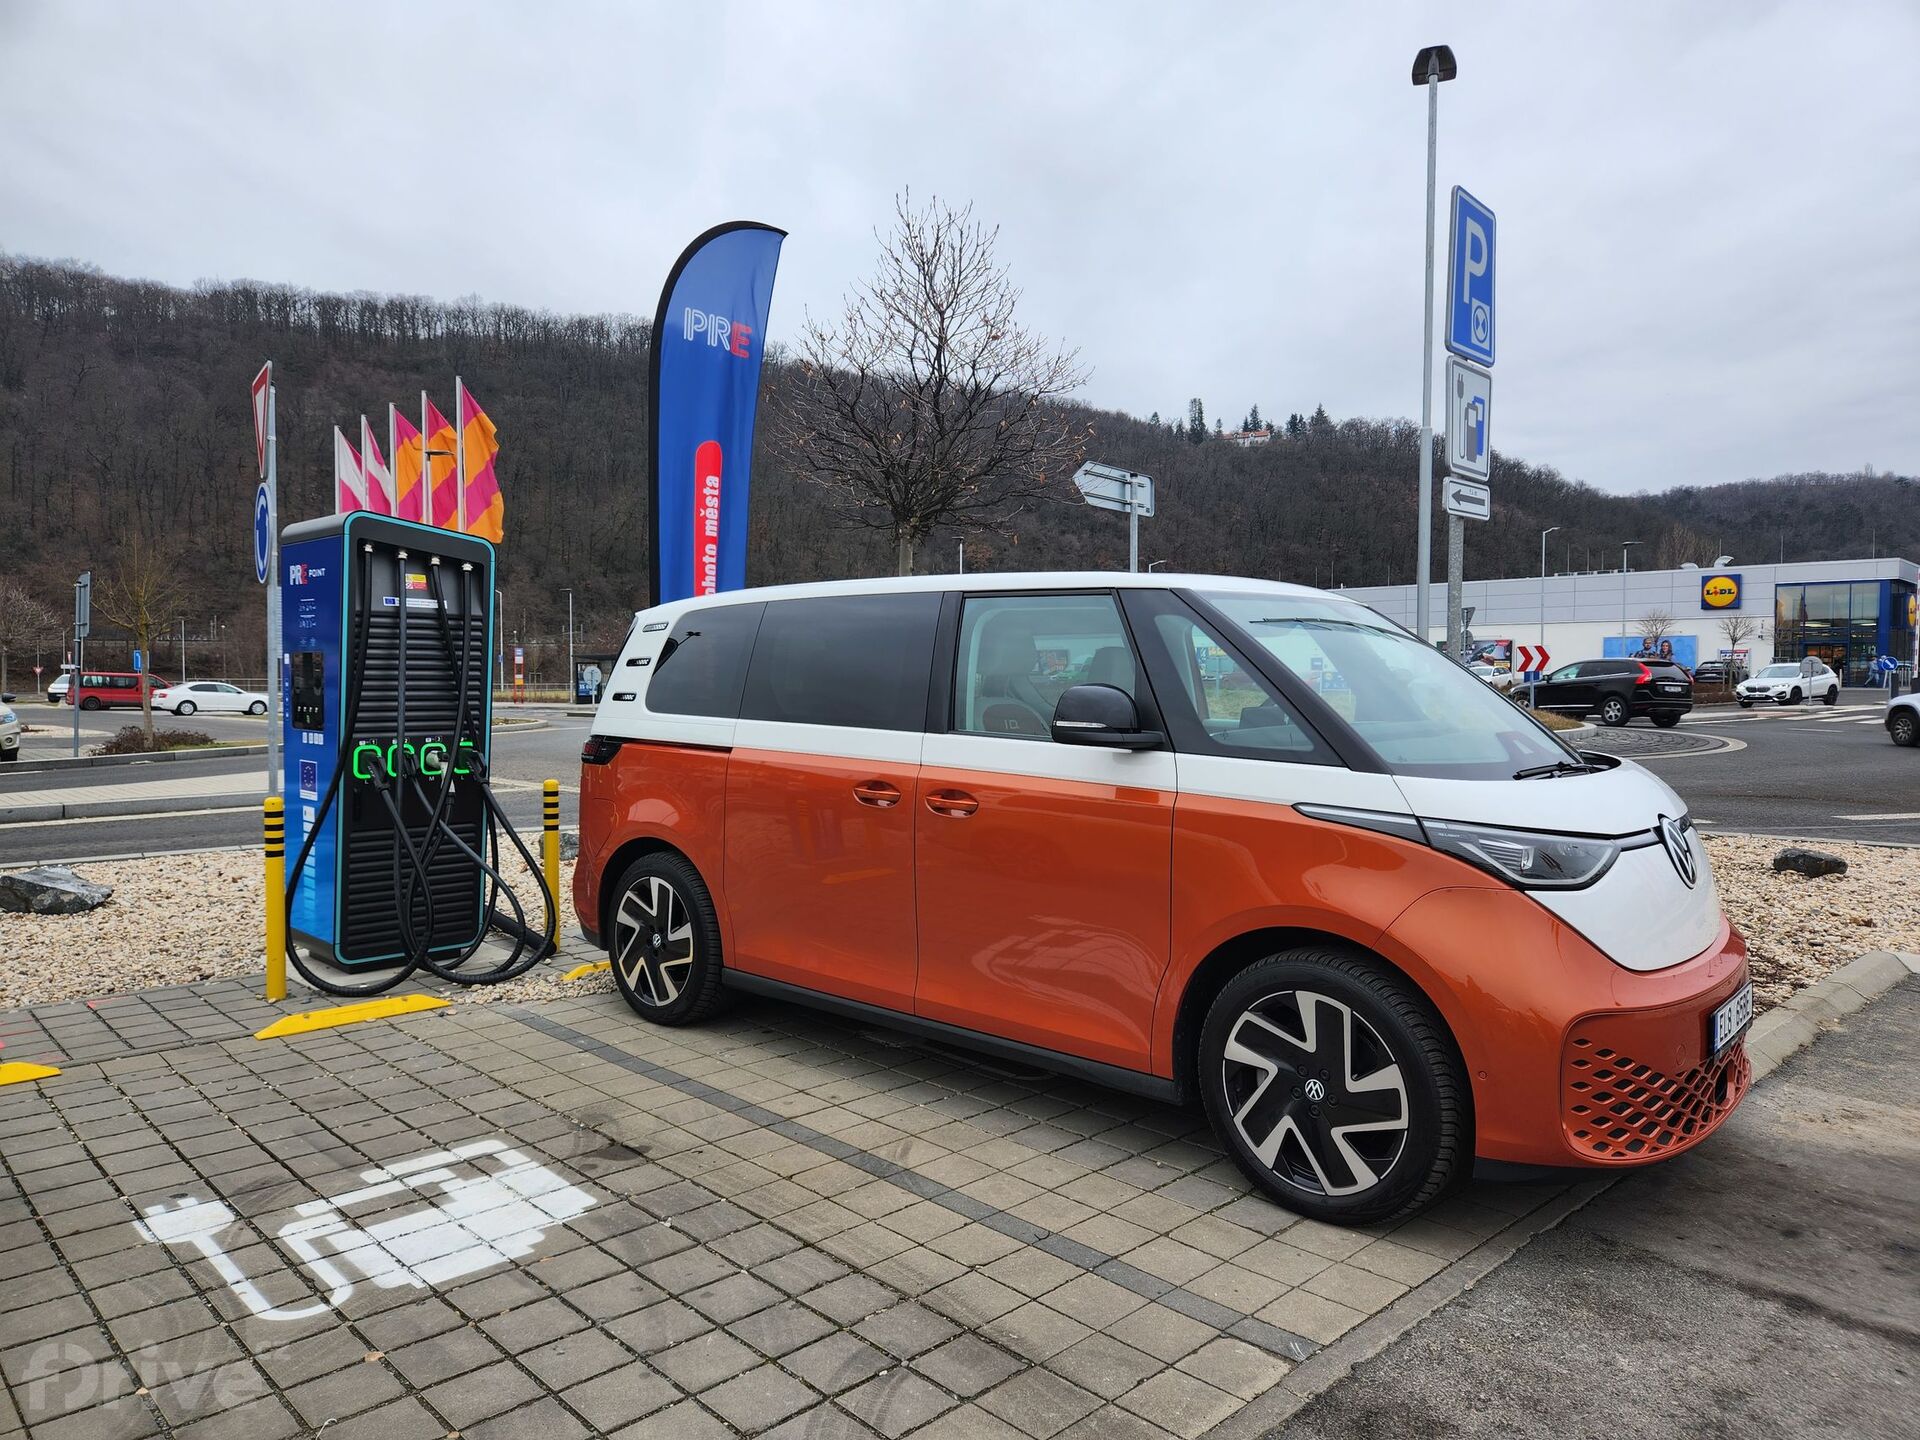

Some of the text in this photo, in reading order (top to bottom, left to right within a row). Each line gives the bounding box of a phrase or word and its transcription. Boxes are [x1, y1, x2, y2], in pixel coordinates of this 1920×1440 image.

[1463, 216, 1488, 305] P
[683, 307, 752, 358] PRE
[700, 475, 719, 537] města
[290, 564, 326, 586] PRE POINT
[1706, 586, 1735, 596] LIDL
